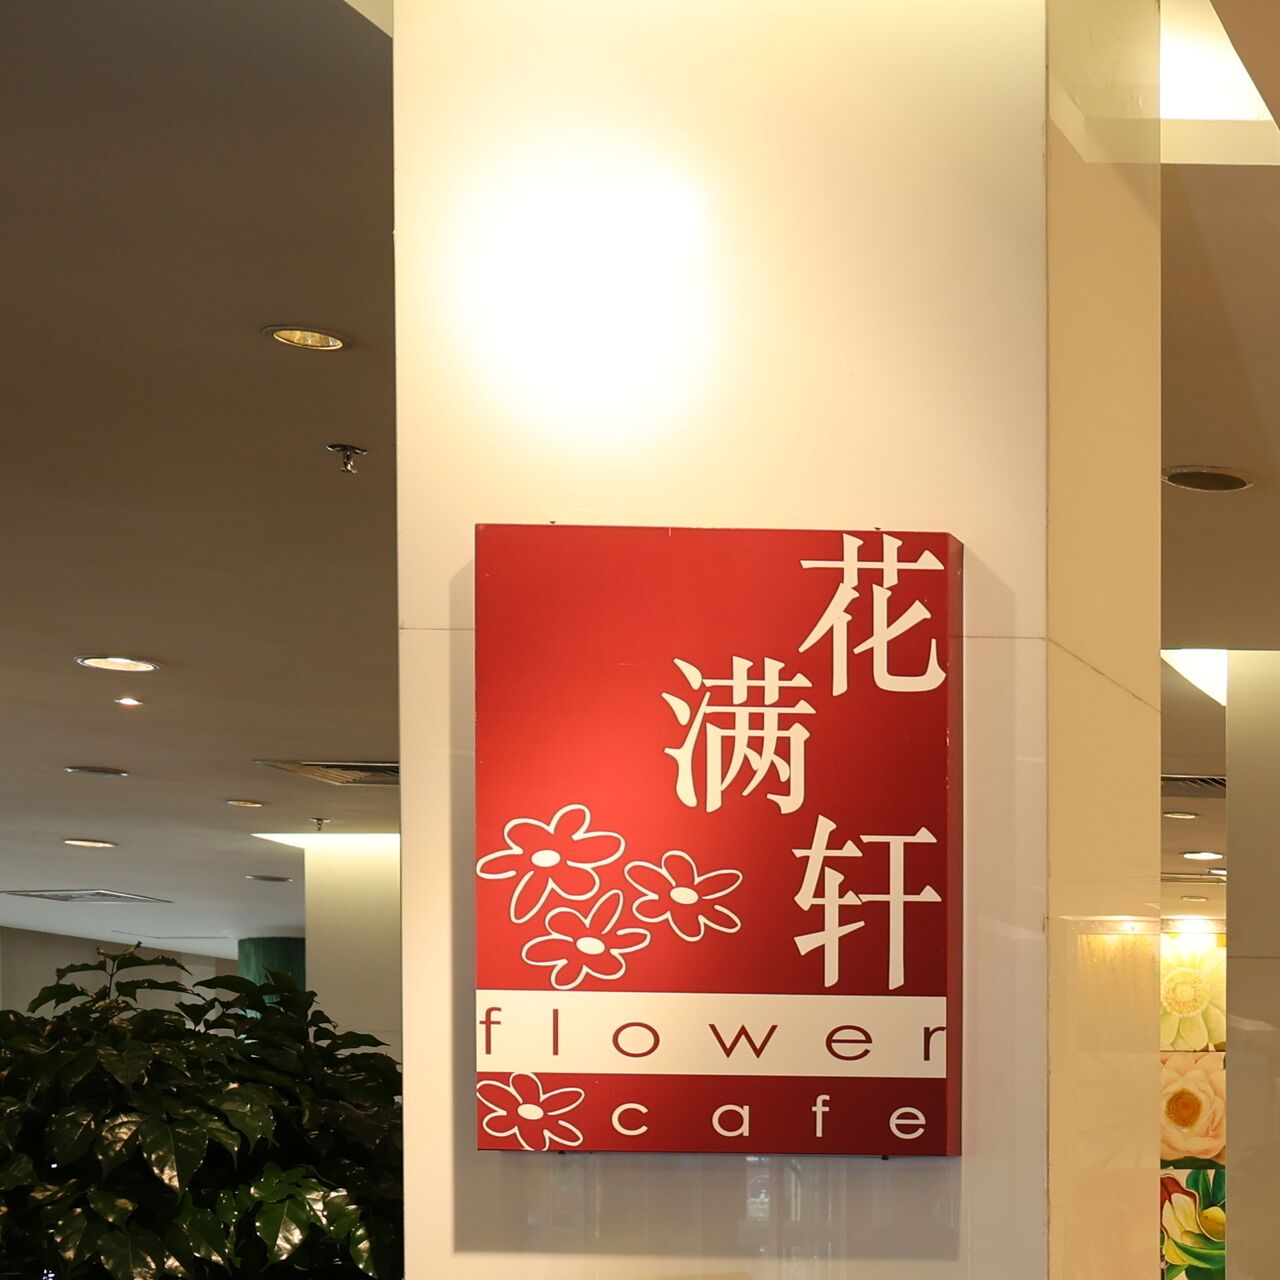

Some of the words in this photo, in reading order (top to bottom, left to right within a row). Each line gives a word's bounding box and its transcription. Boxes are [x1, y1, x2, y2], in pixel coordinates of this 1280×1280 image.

[661, 532, 949, 991] 花满轩
[478, 1006, 948, 1062] flower
[611, 1094, 927, 1140] cafe
